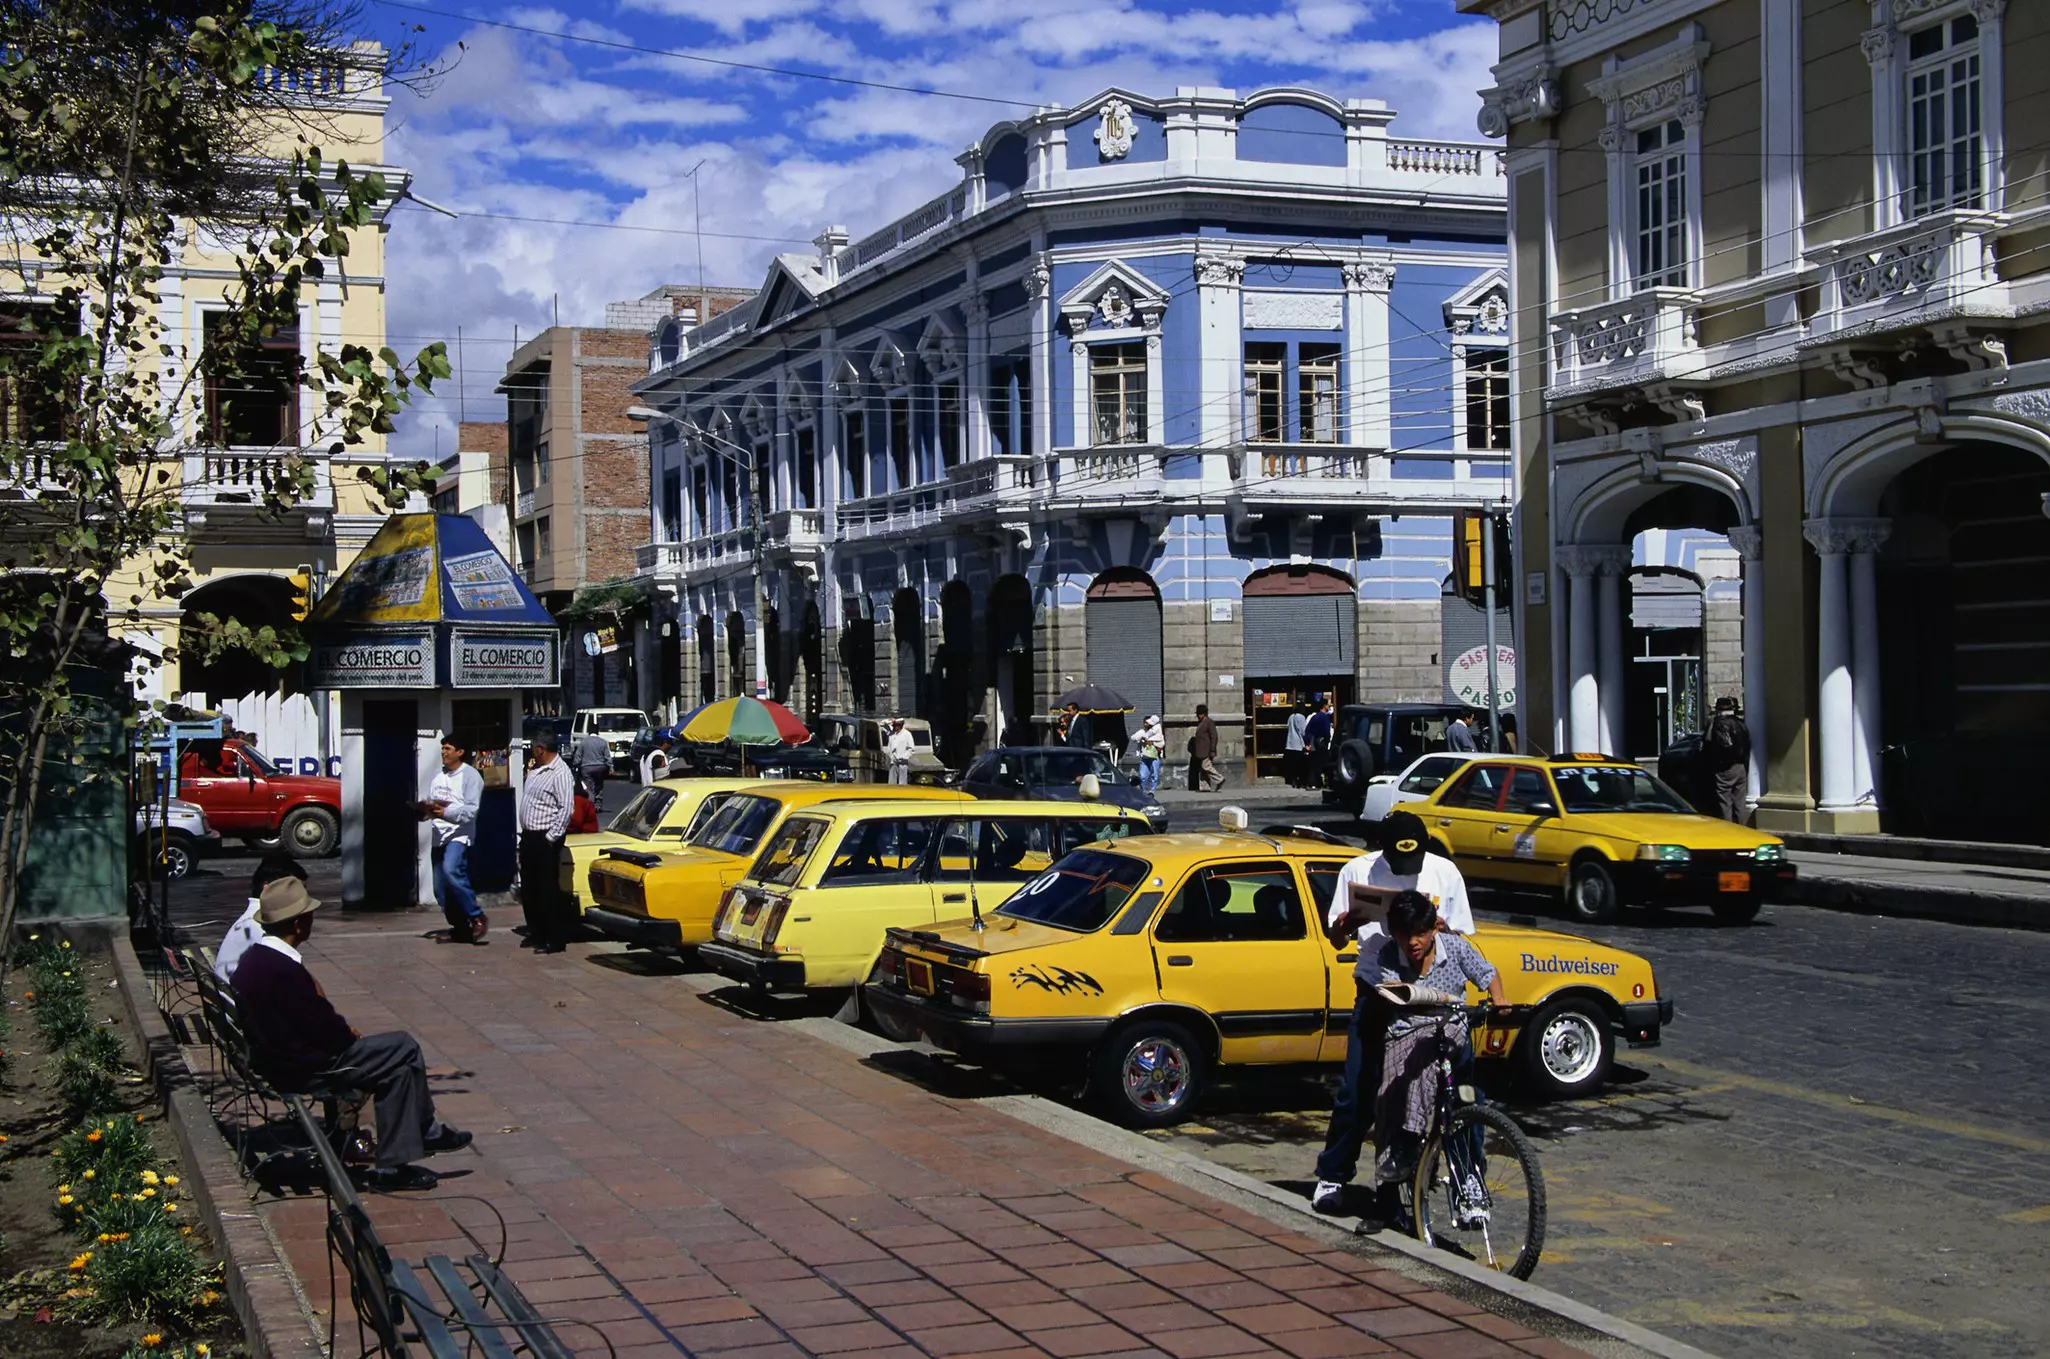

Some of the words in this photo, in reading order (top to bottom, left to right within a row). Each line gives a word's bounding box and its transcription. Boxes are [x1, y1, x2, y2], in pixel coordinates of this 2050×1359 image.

[337, 649, 422, 667] COMERCIO
[462, 648, 477, 665] EL
[479, 649, 545, 665] COMERCIO
[1005, 871, 1060, 904] 20
[1520, 953, 1619, 976] Budweiser
[1634, 985, 1642, 997] 1
